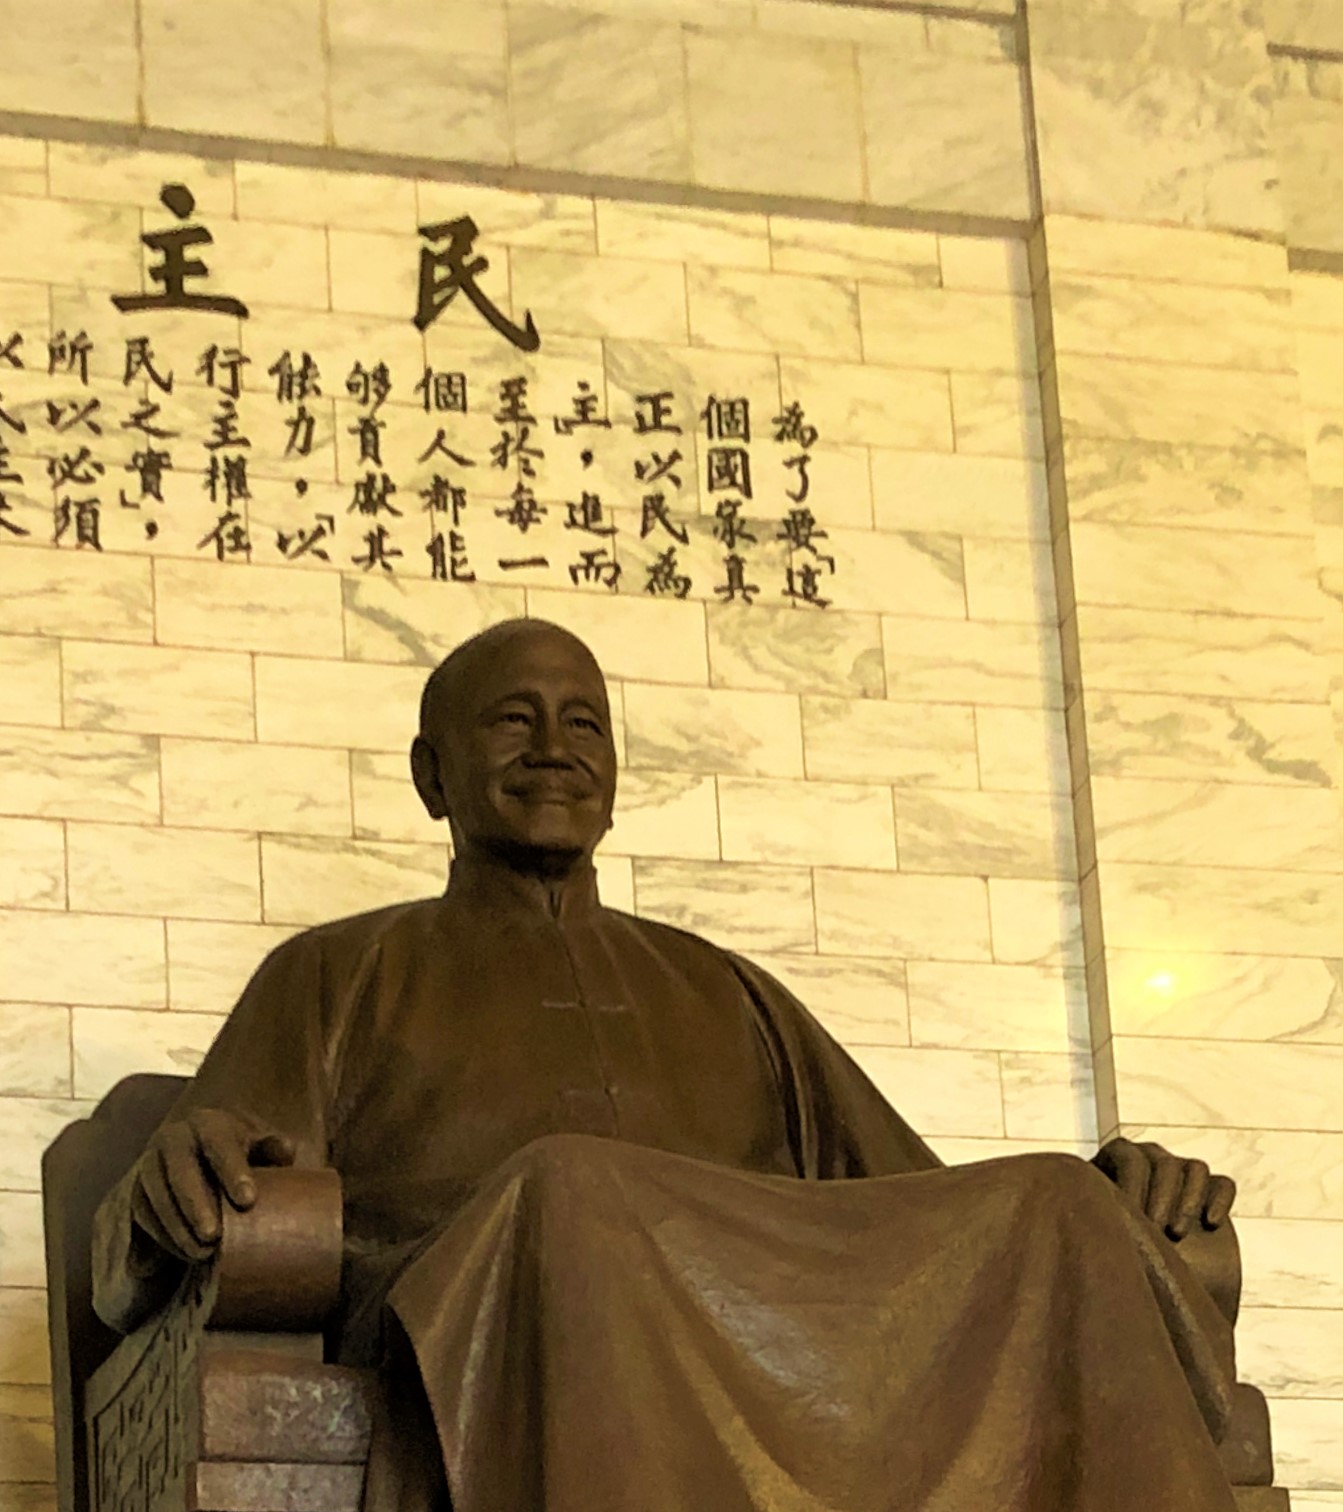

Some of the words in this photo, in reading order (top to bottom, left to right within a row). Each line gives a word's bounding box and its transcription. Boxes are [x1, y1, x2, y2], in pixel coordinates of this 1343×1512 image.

[47, 330, 105, 551] 所以必須
[414, 366, 477, 581] 個人都能
[490, 376, 549, 571] 至於每一
[633, 391, 692, 599] 正以民為
